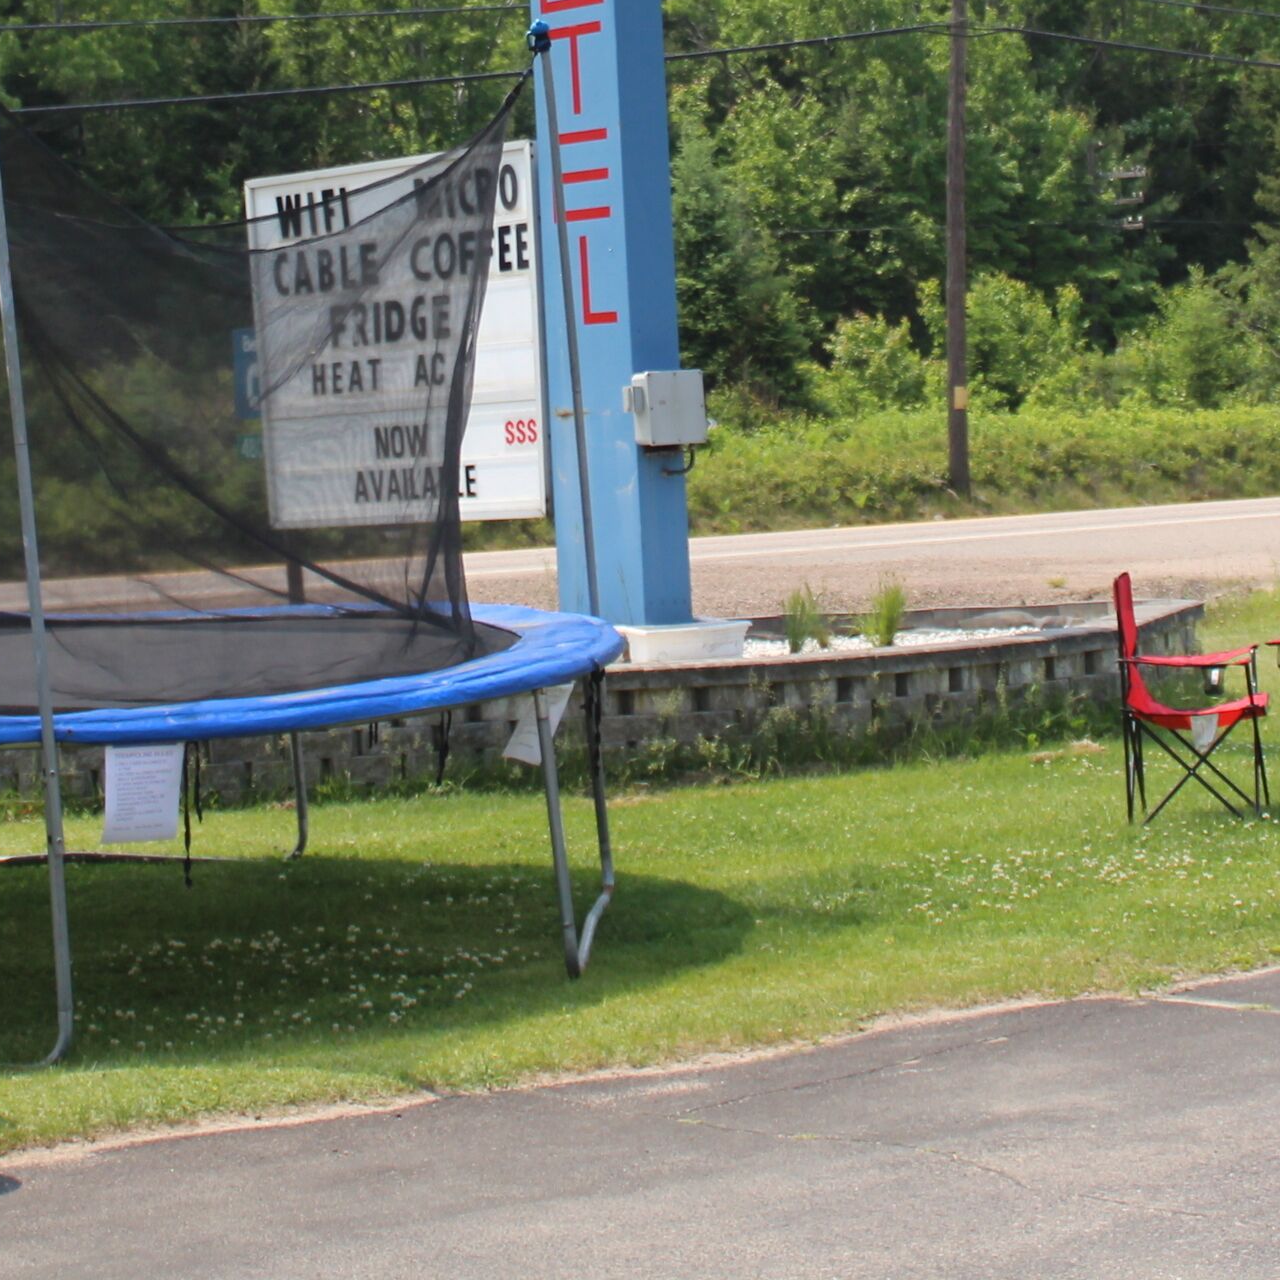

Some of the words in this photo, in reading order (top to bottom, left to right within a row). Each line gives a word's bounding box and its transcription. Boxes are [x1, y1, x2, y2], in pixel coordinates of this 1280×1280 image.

[276, 187, 350, 239] WIFI
[273, 242, 379, 296] CABLE
[329, 296, 450, 349] FRIDGE
[312, 358, 381, 395] HEAT
[414, 353, 445, 388] AC
[374, 423, 428, 459] NOW
[354, 464, 477, 504] AVAILAE
